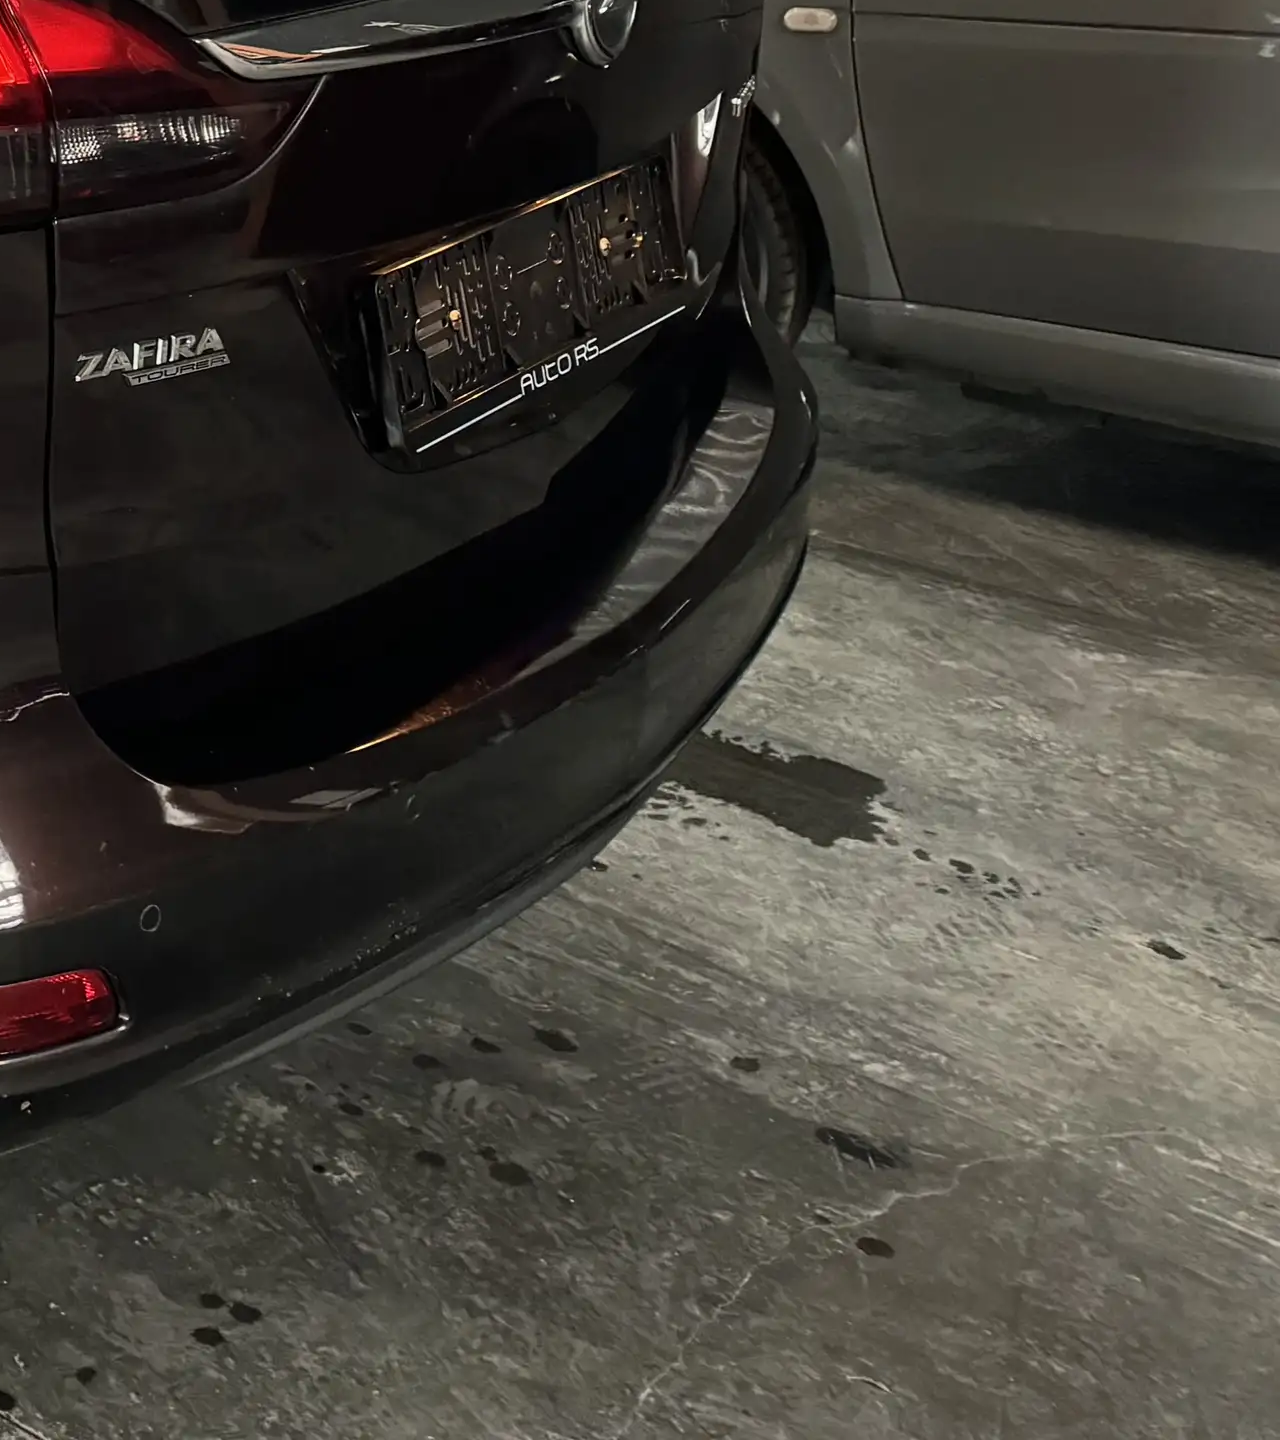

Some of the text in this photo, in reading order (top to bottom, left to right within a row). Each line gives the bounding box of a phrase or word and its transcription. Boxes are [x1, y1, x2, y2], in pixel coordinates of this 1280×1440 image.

[74, 326, 226, 383] ZAFIRA
[573, 337, 600, 367] RS
[130, 356, 227, 385] TOURER
